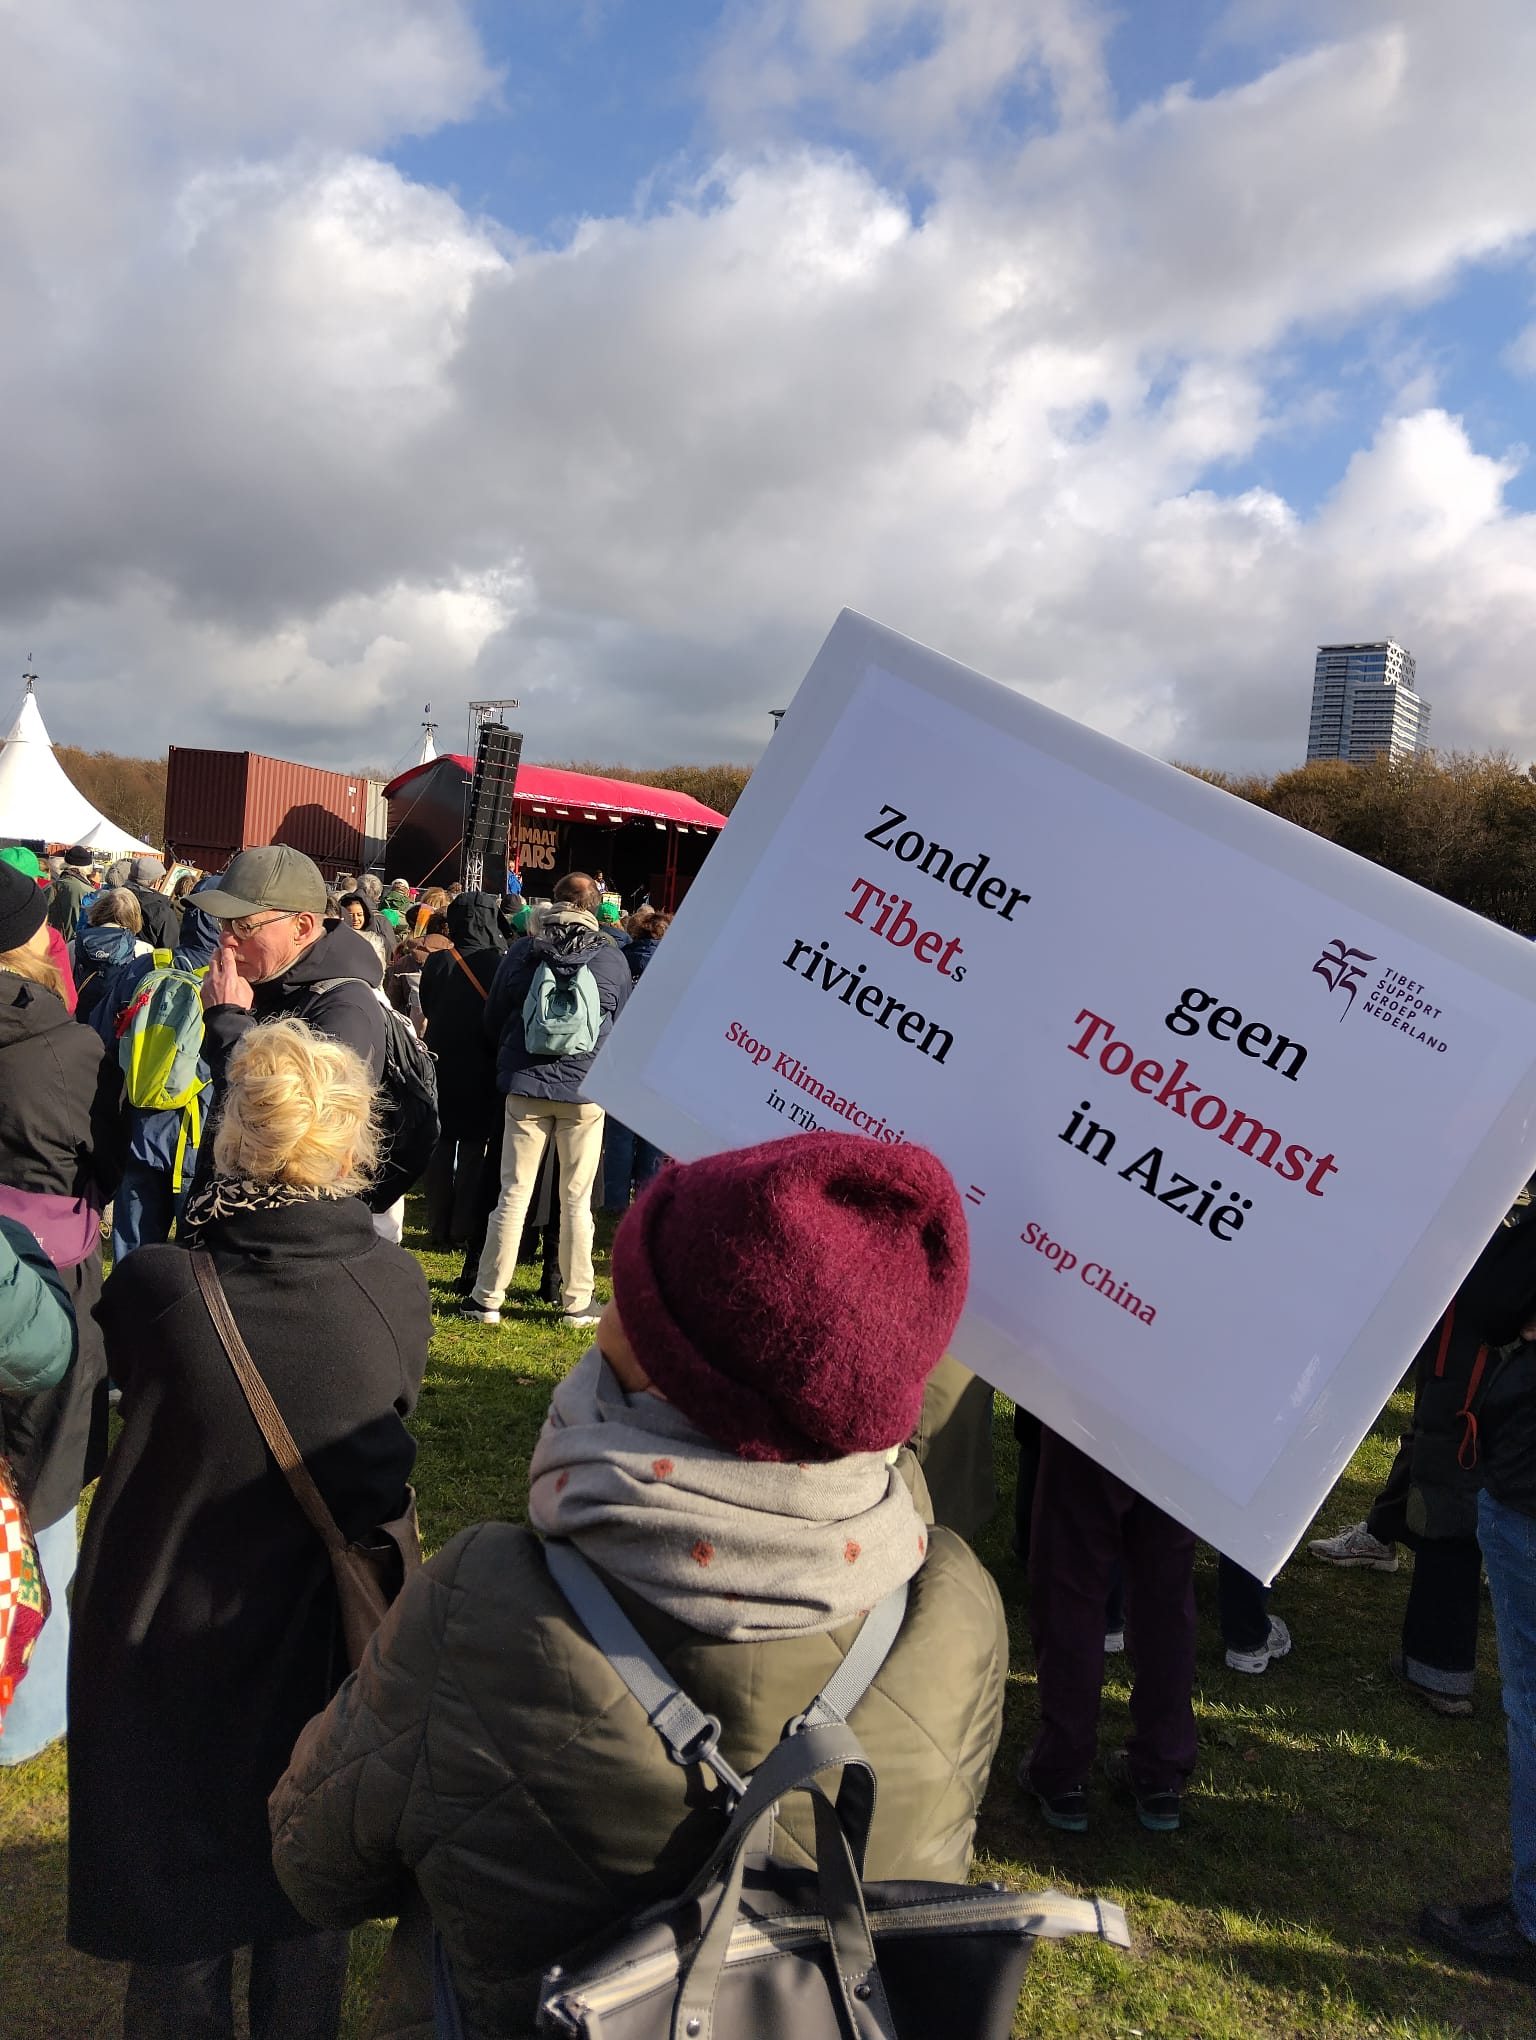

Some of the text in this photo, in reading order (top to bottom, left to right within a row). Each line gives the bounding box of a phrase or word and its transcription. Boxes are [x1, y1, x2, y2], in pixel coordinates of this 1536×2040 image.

[510, 826, 556, 846] LIMAAT
[518, 843, 556, 870] ARS
[863, 804, 1032, 922] Zonder
[844, 877, 967, 983] Tibets
[782, 938, 954, 1065] rivieren
[1362, 1001, 1448, 1053] NEDERLAND
[1370, 991, 1417, 1020] GROEP
[1376, 979, 1442, 1020] SUPPORT
[1384, 967, 1425, 995] TIBET
[1164, 987, 1308, 1082] geen
[724, 1021, 912, 1146] Stop Klimaatcrisi
[765, 1088, 834, 1132] in Tib
[1067, 1008, 1339, 1197] Toekomst
[1057, 1100, 1253, 1242] in Azië
[1019, 1222, 1157, 1326] Stop China
